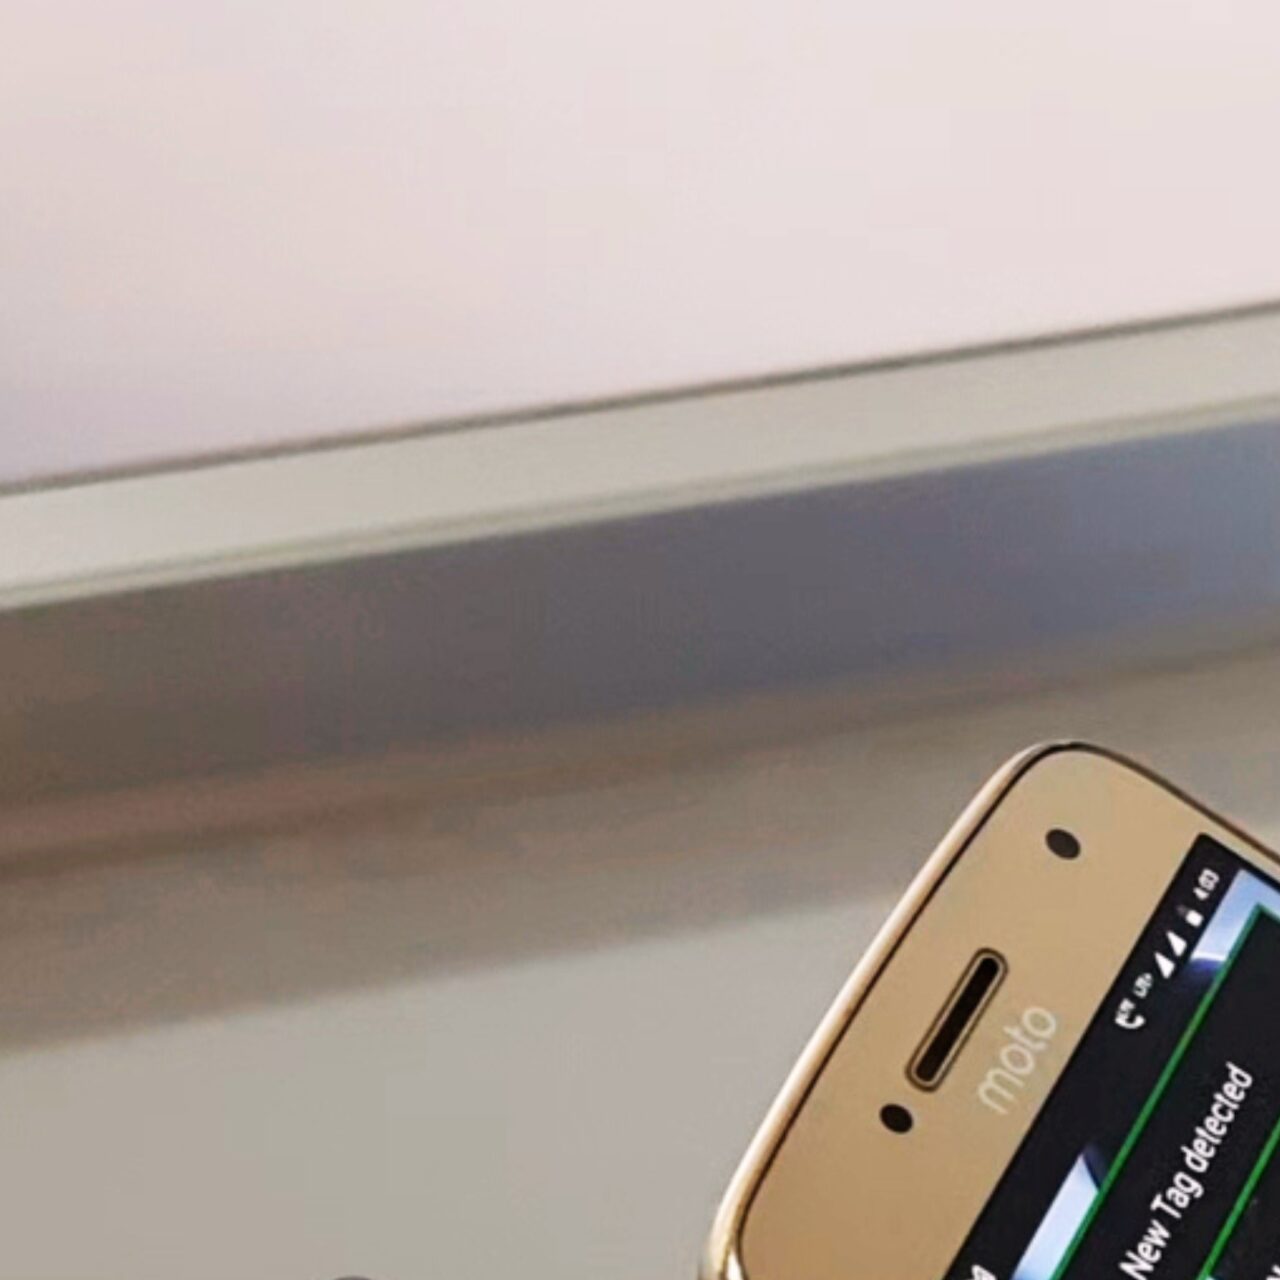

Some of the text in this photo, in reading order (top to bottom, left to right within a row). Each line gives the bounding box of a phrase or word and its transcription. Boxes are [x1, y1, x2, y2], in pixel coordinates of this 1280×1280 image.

[976, 1006, 1057, 1115] moto
[1150, 1171, 1204, 1219] Tag
[1181, 1061, 1253, 1173] detected
